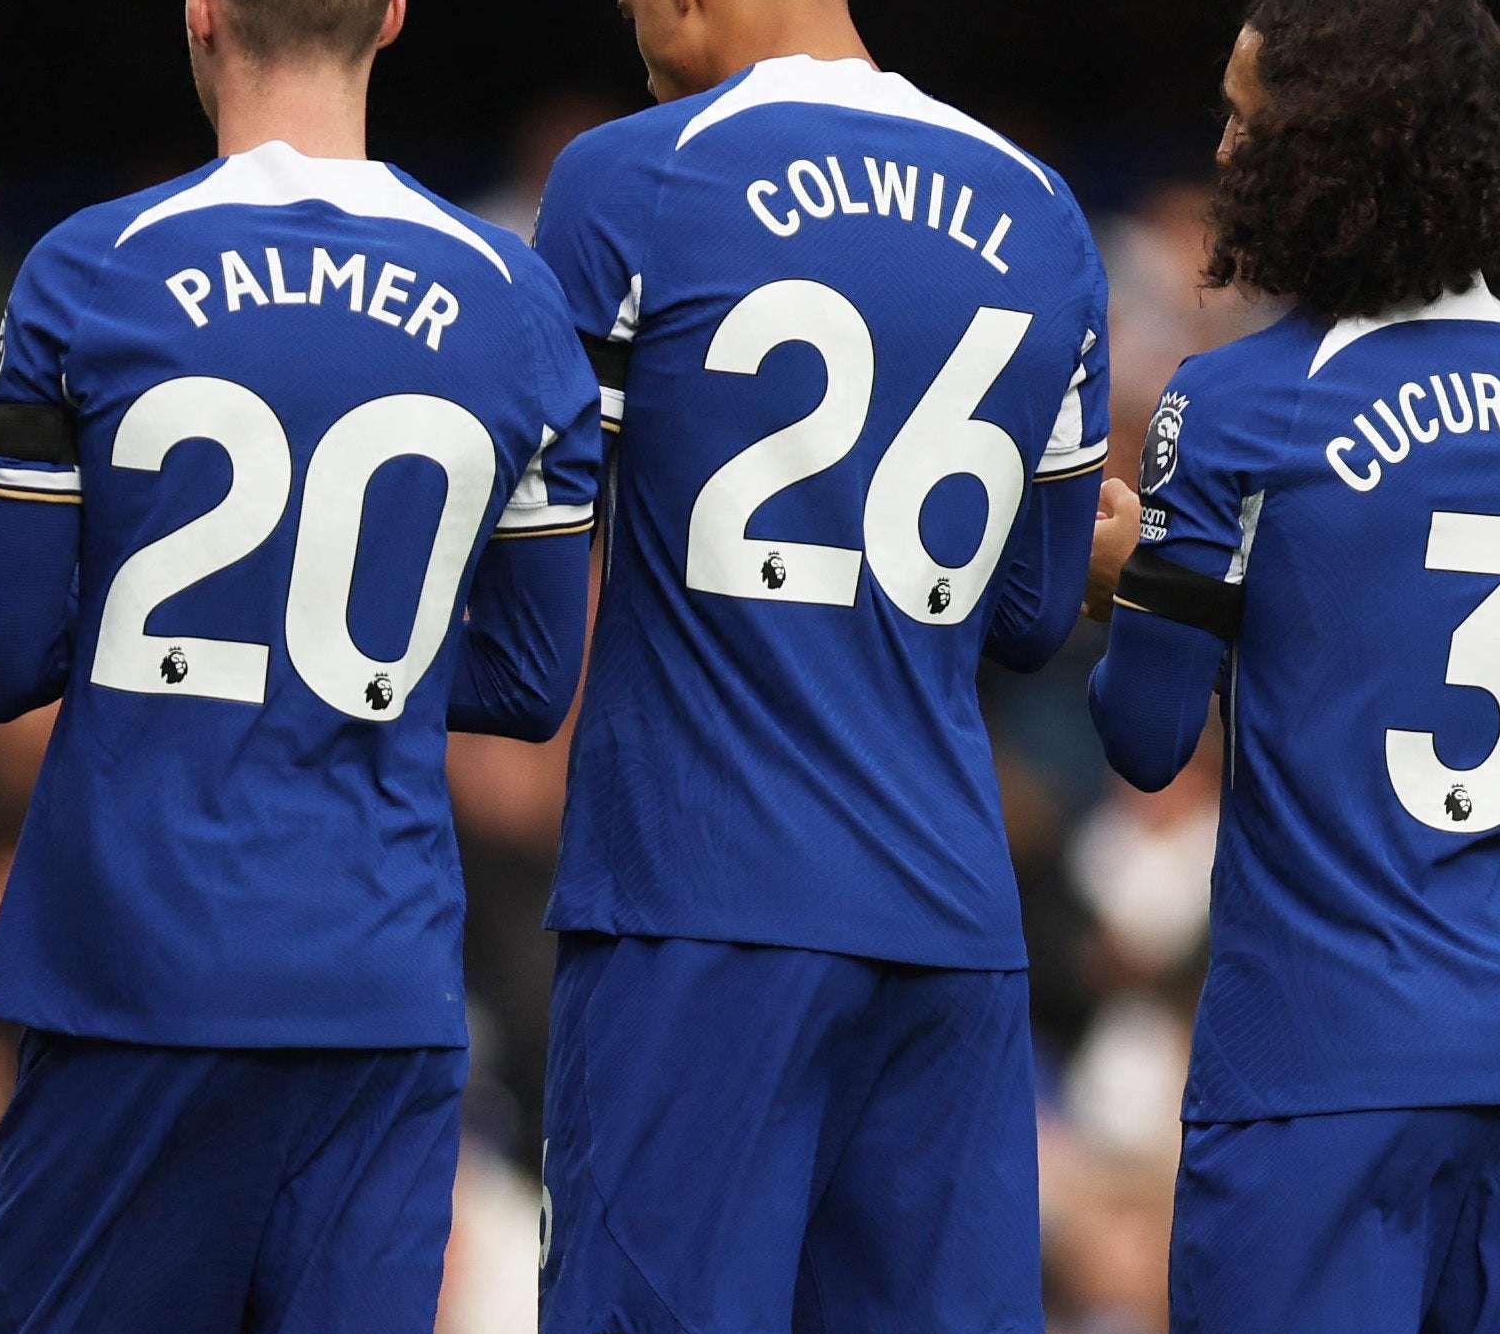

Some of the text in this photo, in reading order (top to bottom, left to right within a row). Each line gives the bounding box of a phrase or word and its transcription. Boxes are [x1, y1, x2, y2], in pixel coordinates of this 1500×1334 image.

[165, 248, 459, 351] PALMER
[747, 155, 1013, 274] COLWILL
[90, 375, 496, 722] 20
[686, 278, 1025, 625] 26
